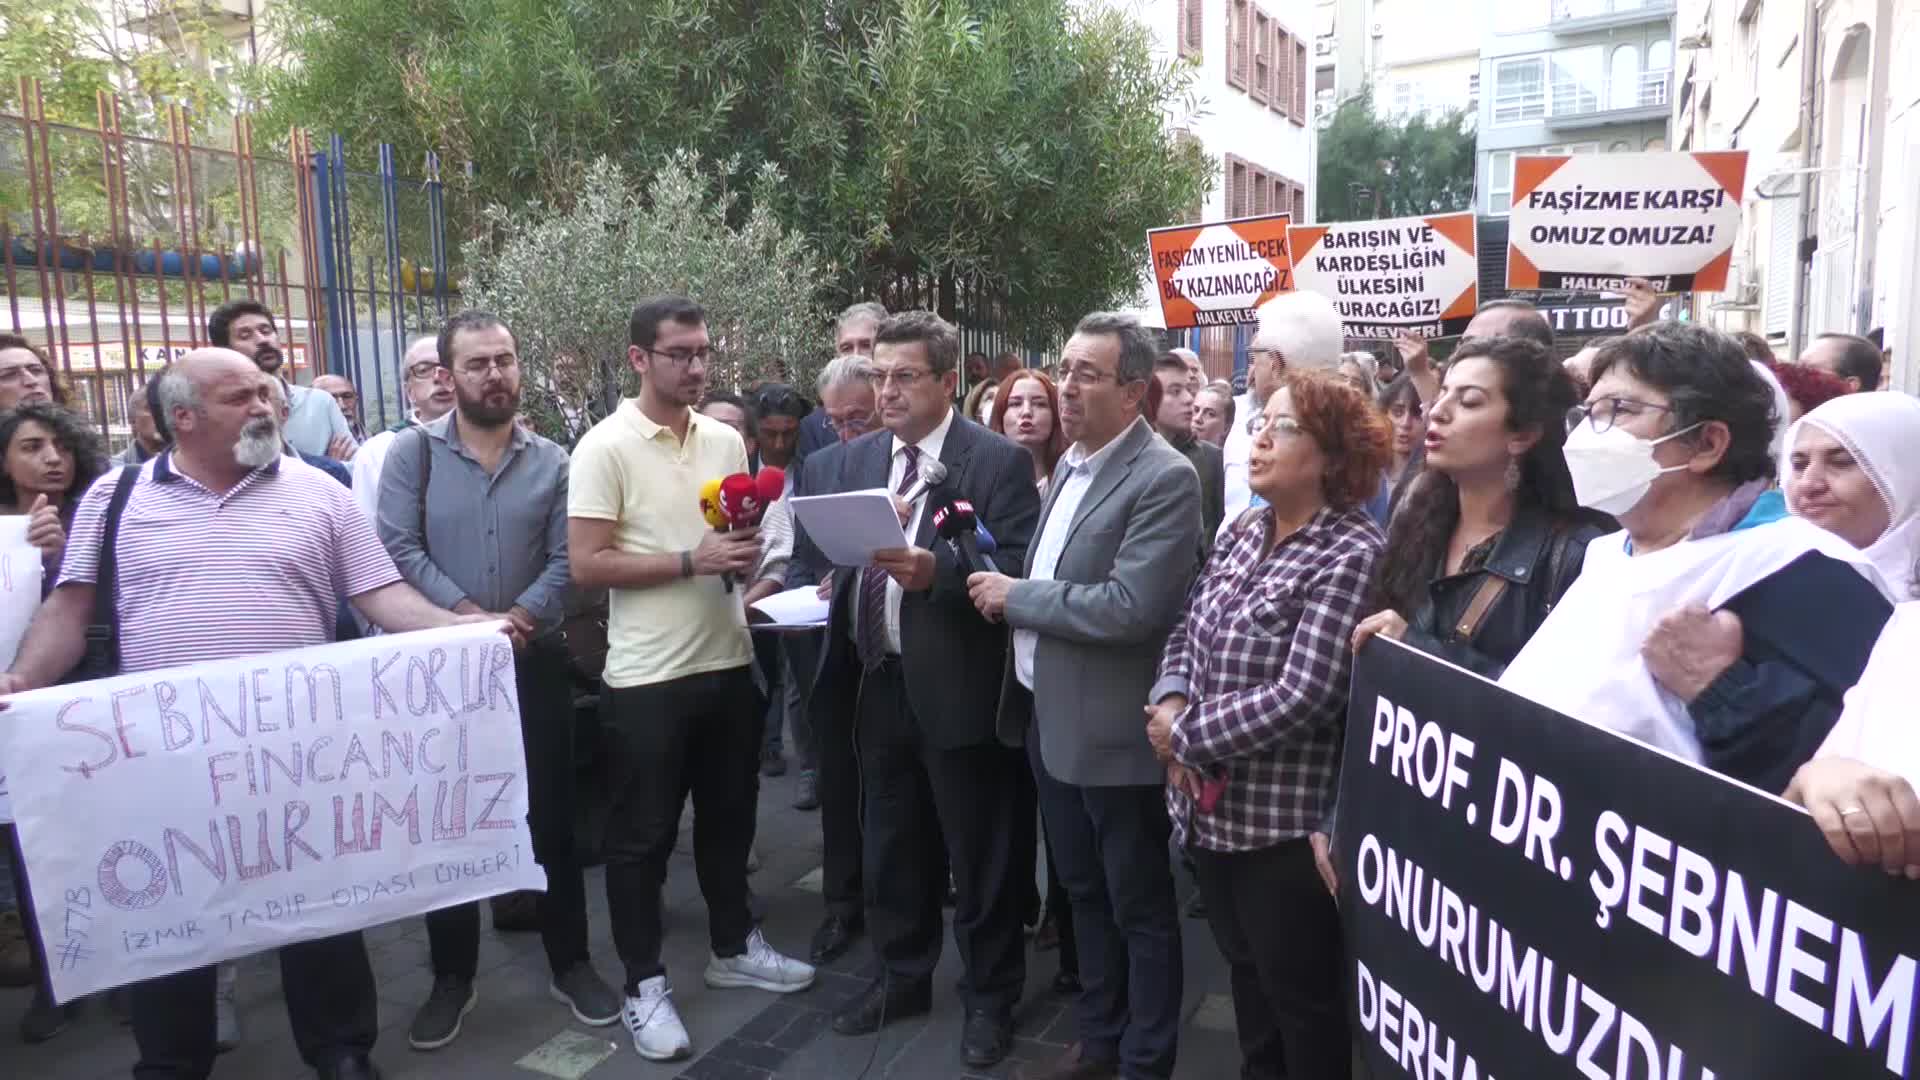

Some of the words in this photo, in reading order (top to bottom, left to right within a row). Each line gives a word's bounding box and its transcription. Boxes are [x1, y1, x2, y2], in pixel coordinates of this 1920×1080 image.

[1529, 184, 1640, 216] FAŞİZME
[1643, 188, 1725, 215] KARŞI
[1323, 228, 1401, 252] BARIŞIN
[1407, 225, 1434, 244] VE
[1530, 225, 1606, 245] OMUZ
[1608, 223, 1716, 246] OMUZA!
[1157, 245, 1206, 271] FAŞİZM
[1207, 238, 1287, 265] YENİLECEK
[1316, 247, 1446, 276] KARDEŞLİĞİN
[1163, 278, 1186, 300] BİZ
[1187, 267, 1289, 298] KAZANACAĞIZ
[1337, 271, 1424, 295] ÜLKESİNİ
[1334, 296, 1441, 318] URACAĞIZ!
[1541, 306, 1628, 330] TTOO
[56, 663, 343, 779] ŞEBNEM
[371, 643, 515, 720] KORUR
[207, 720, 468, 806] FİNCANCI
[97, 772, 517, 912] ONURUMUZ
[332, 870, 417, 907] ODASI
[1369, 694, 1477, 826] PROF.
[1490, 756, 1572, 881] DR.
[1589, 809, 1919, 1078] ŞEBNEM
